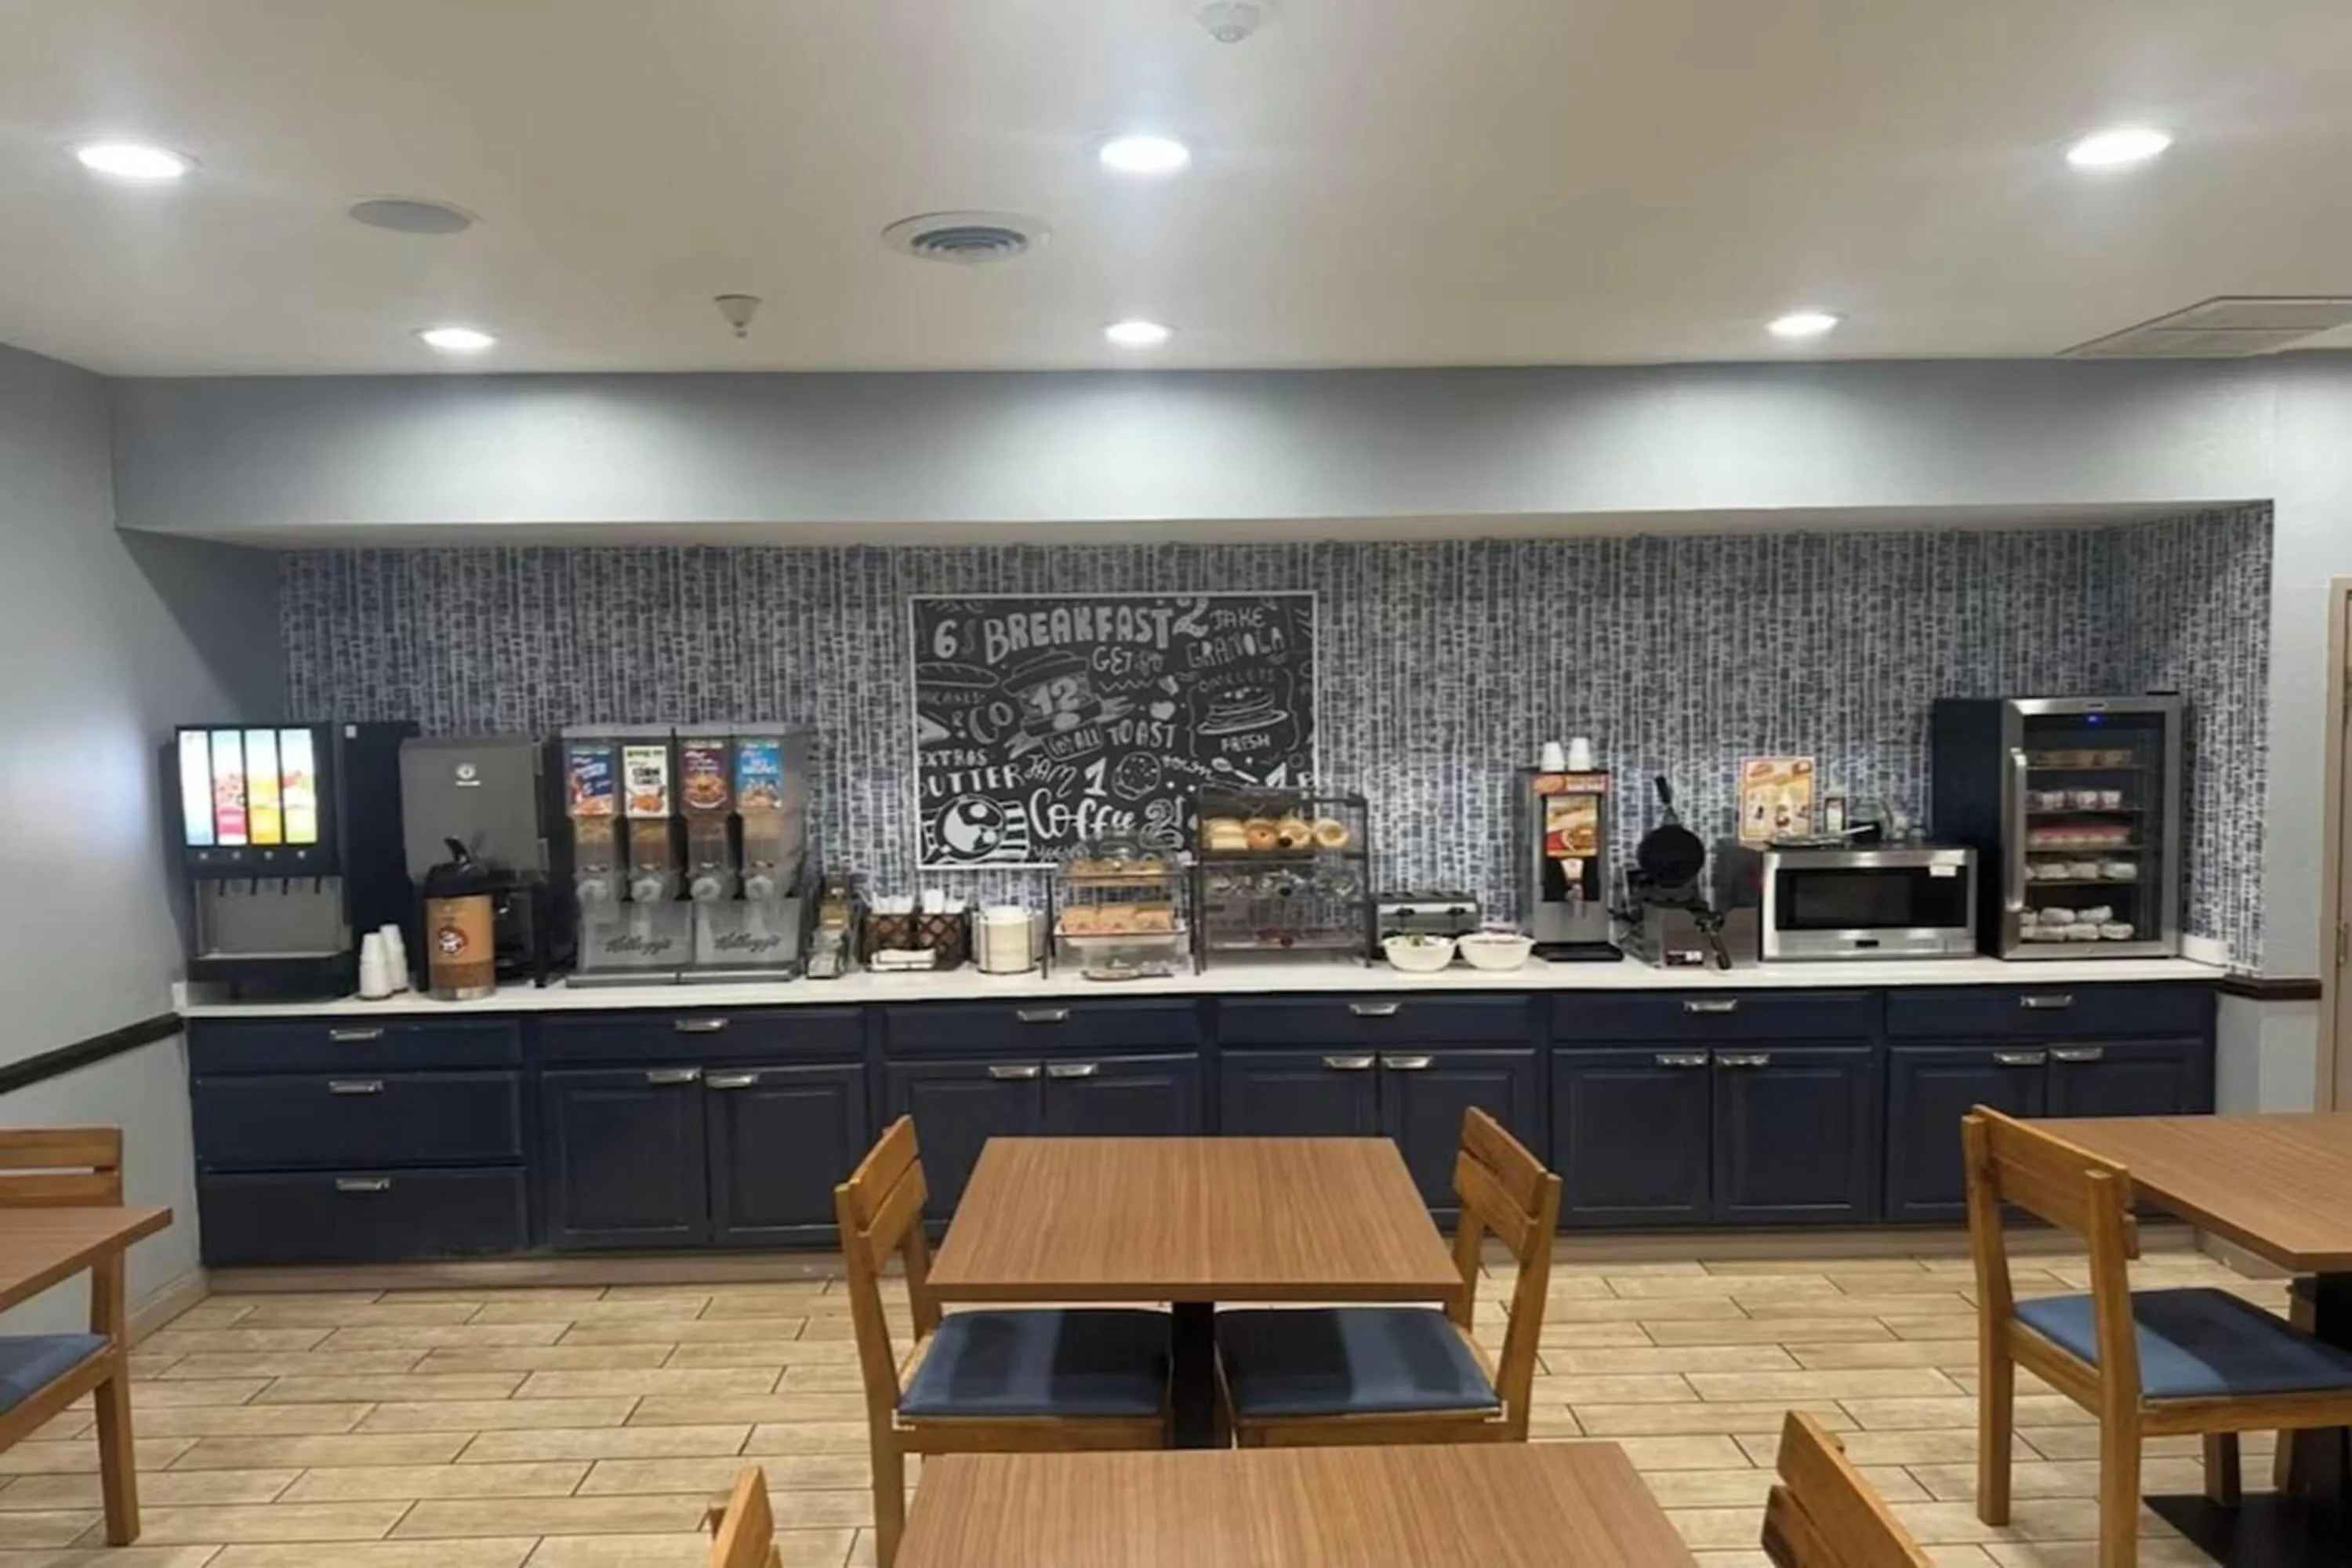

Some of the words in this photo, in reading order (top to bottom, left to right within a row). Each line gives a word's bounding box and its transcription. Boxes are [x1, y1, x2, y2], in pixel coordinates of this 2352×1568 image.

[983, 604, 1174, 666] BREAKFAST
[1186, 626, 1286, 668] GRANOLA
[1092, 645, 1133, 676] GET
[1105, 719, 1178, 749] TOAST
[1029, 786, 1138, 842] Coffee
